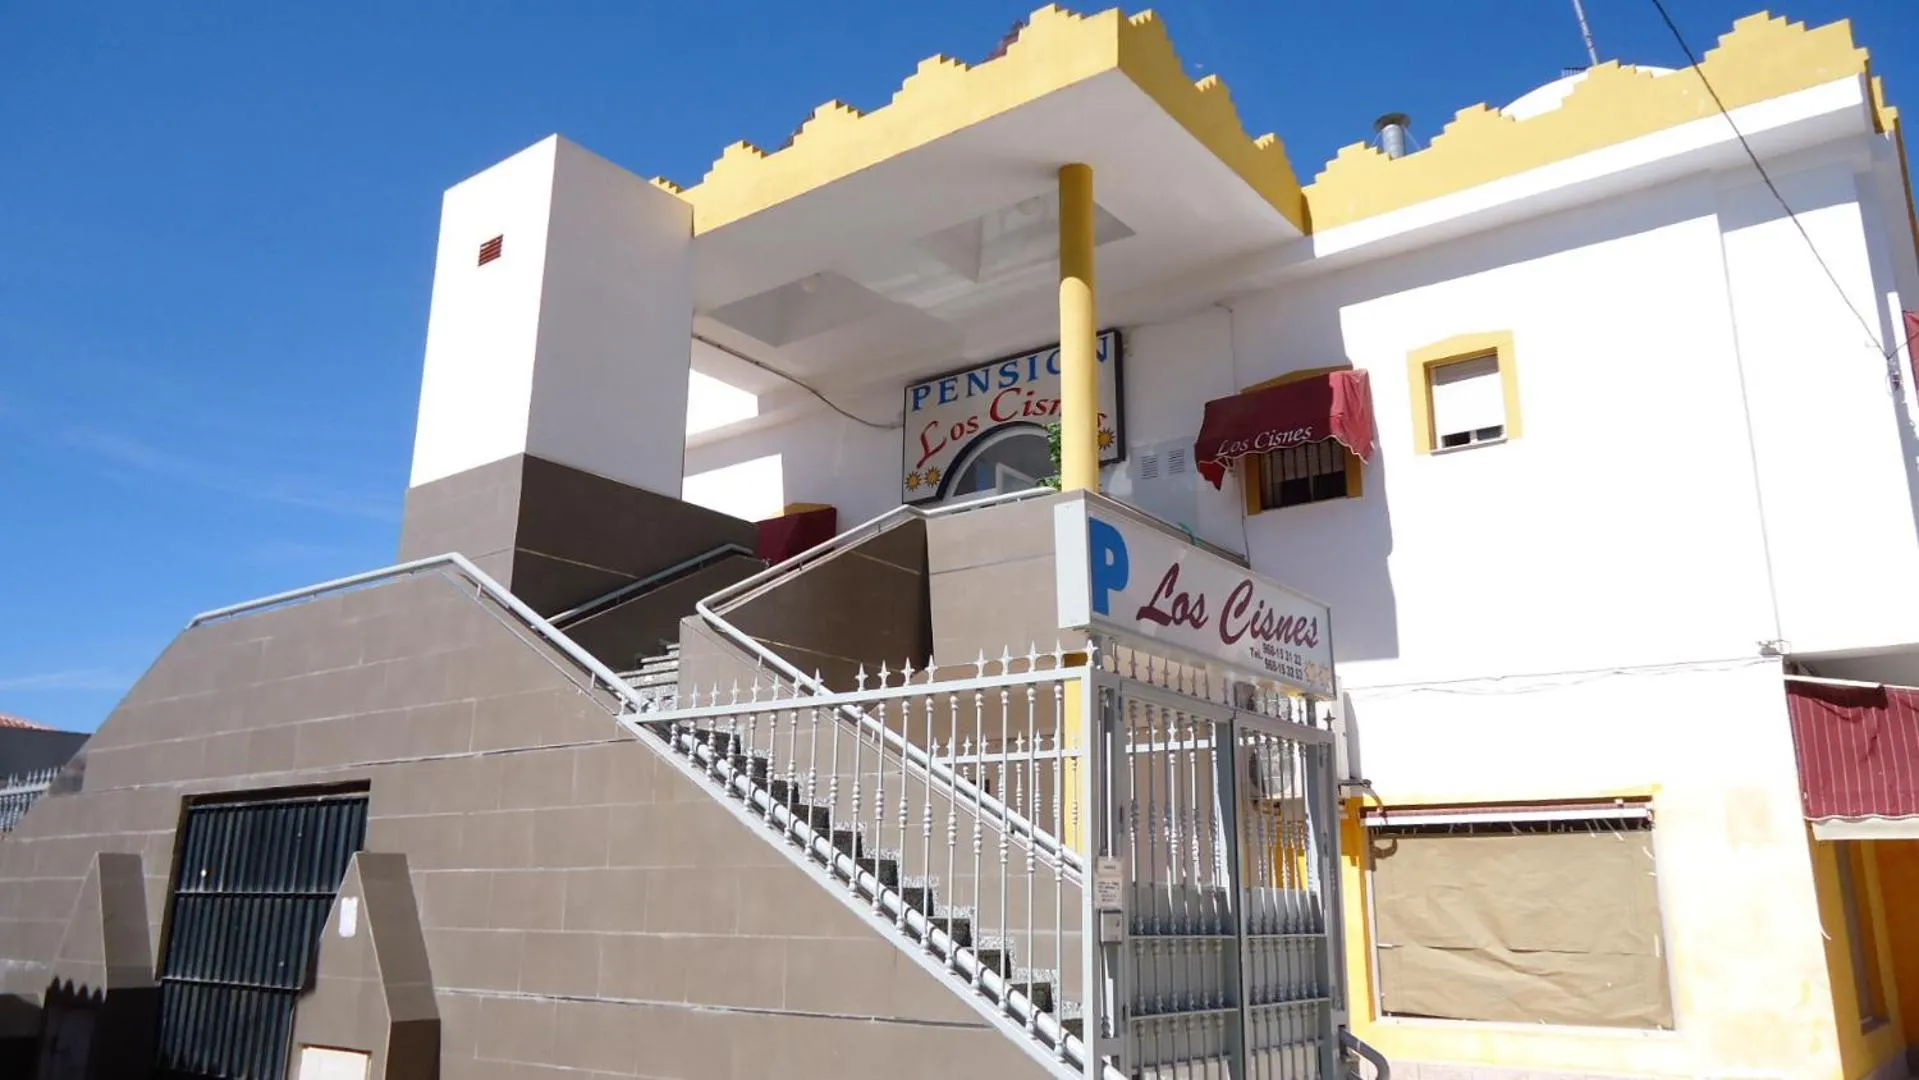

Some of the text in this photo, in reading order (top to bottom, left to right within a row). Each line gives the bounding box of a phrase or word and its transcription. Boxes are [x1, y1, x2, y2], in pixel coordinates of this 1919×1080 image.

[916, 387, 1108, 469] Los Cisn
[1215, 426, 1314, 457] Los Cisnes
[1088, 516, 1129, 616] P
[1136, 562, 1318, 648] Los Cisnes
